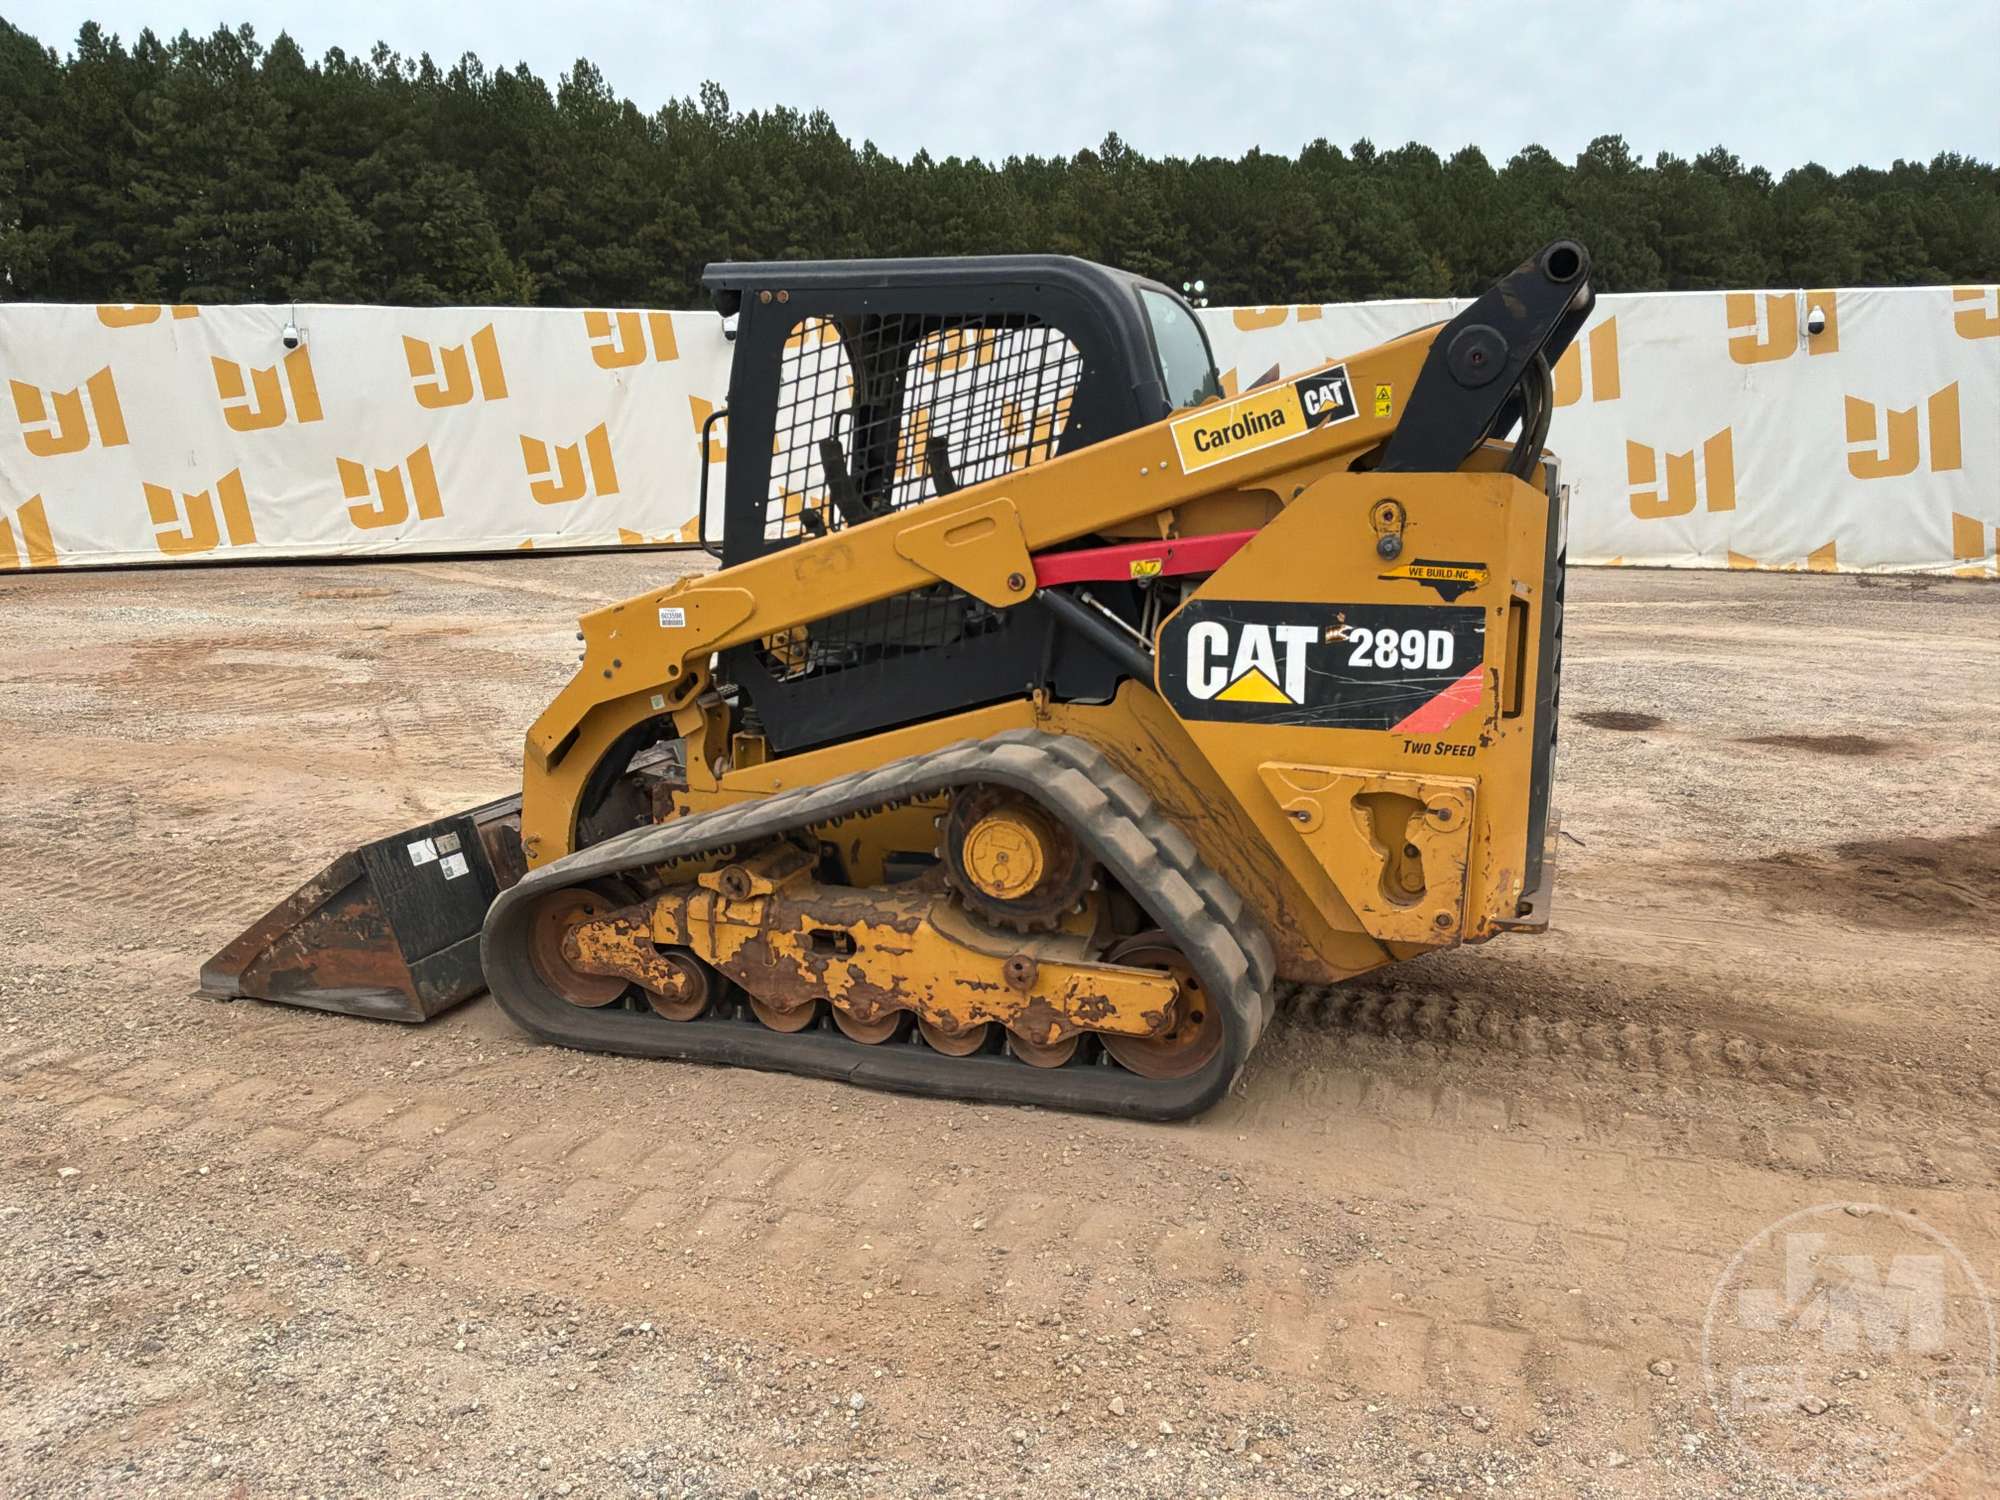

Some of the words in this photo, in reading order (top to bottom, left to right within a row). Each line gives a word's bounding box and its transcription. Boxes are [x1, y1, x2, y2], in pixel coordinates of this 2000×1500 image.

[1193, 407, 1286, 452] Carolina
[1302, 380, 1345, 416] CAT
[1409, 567, 1424, 577] WE
[1426, 568, 1453, 579] BUILD
[1186, 621, 1319, 705] CAT
[1348, 627, 1455, 671] 289D
